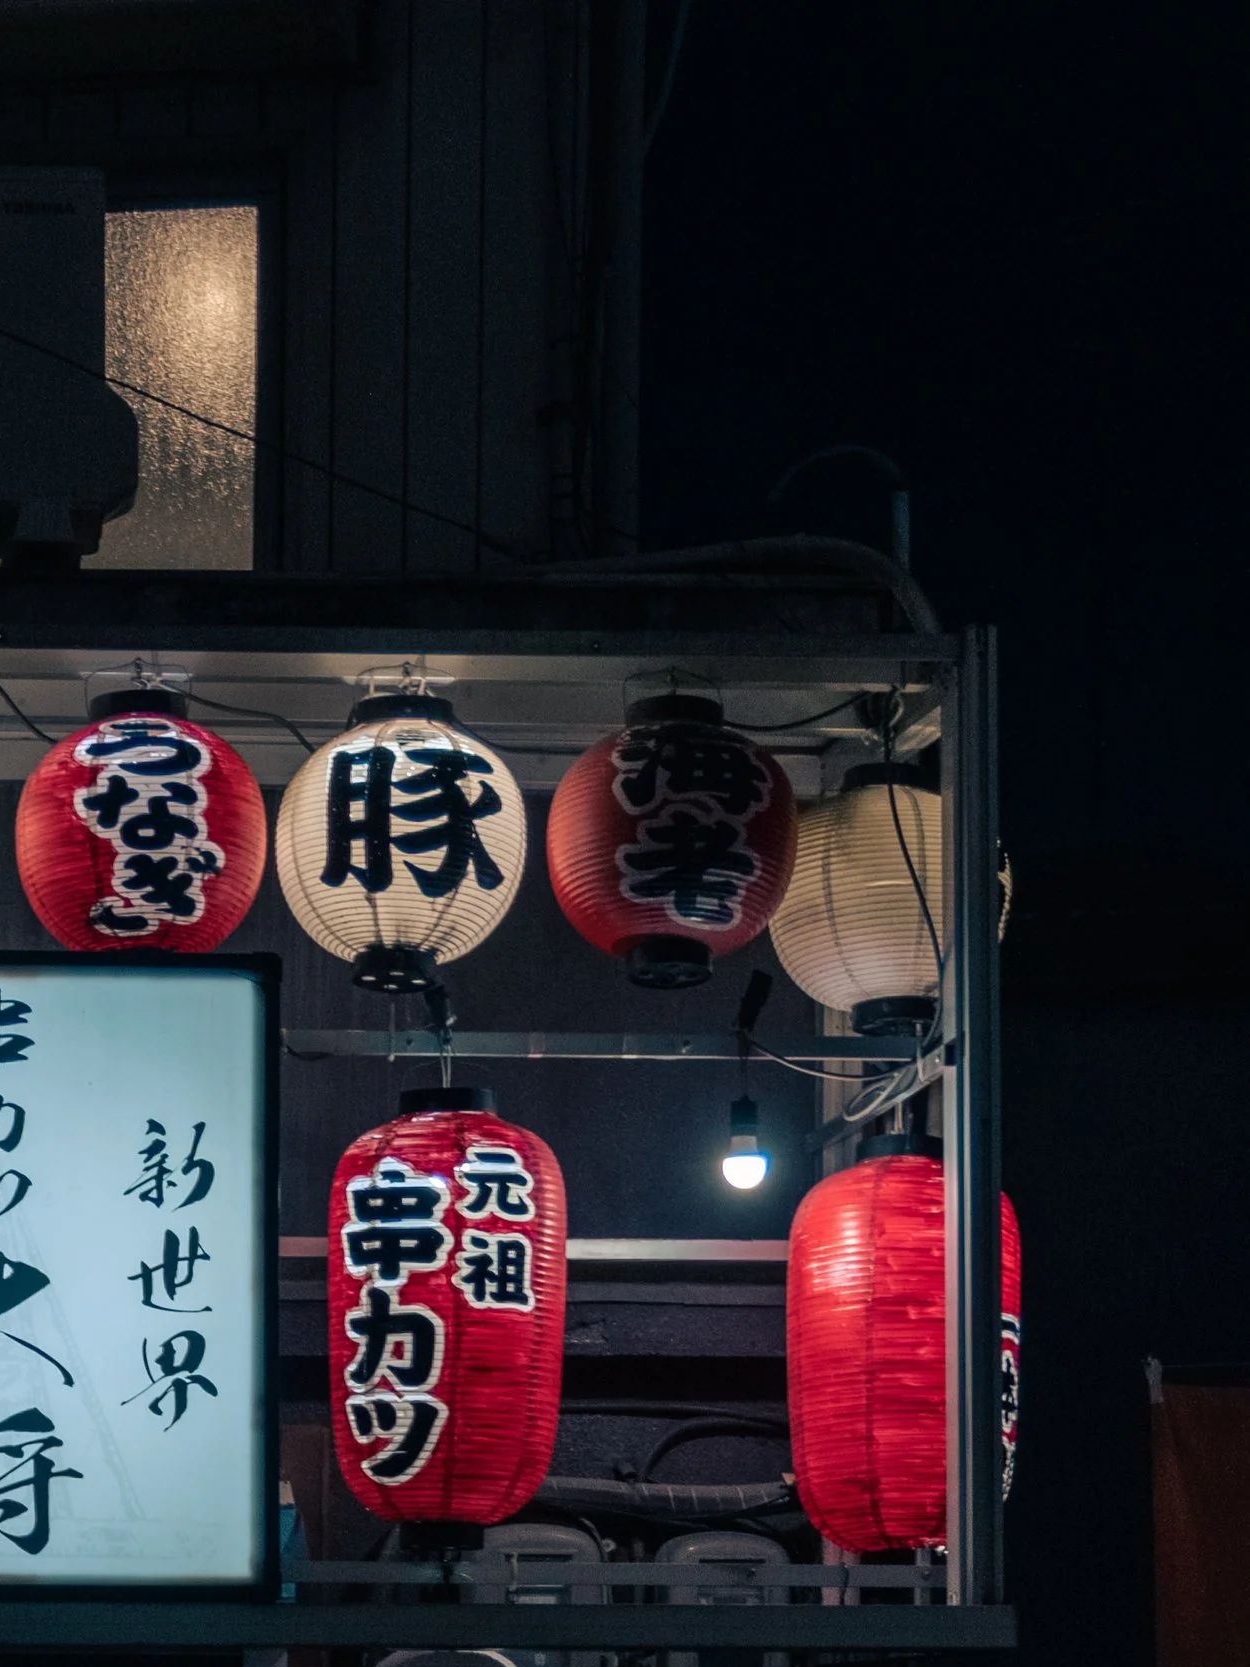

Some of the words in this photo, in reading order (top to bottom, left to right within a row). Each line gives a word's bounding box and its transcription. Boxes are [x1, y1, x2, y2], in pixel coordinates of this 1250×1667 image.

[80, 719, 222, 932] うなぎ
[320, 747, 505, 898] 豚
[617, 722, 768, 925] 海老
[120, 1118, 218, 1432] 新世界
[348, 1170, 445, 1478] 串カツ
[461, 1151, 530, 1304] 元祖
